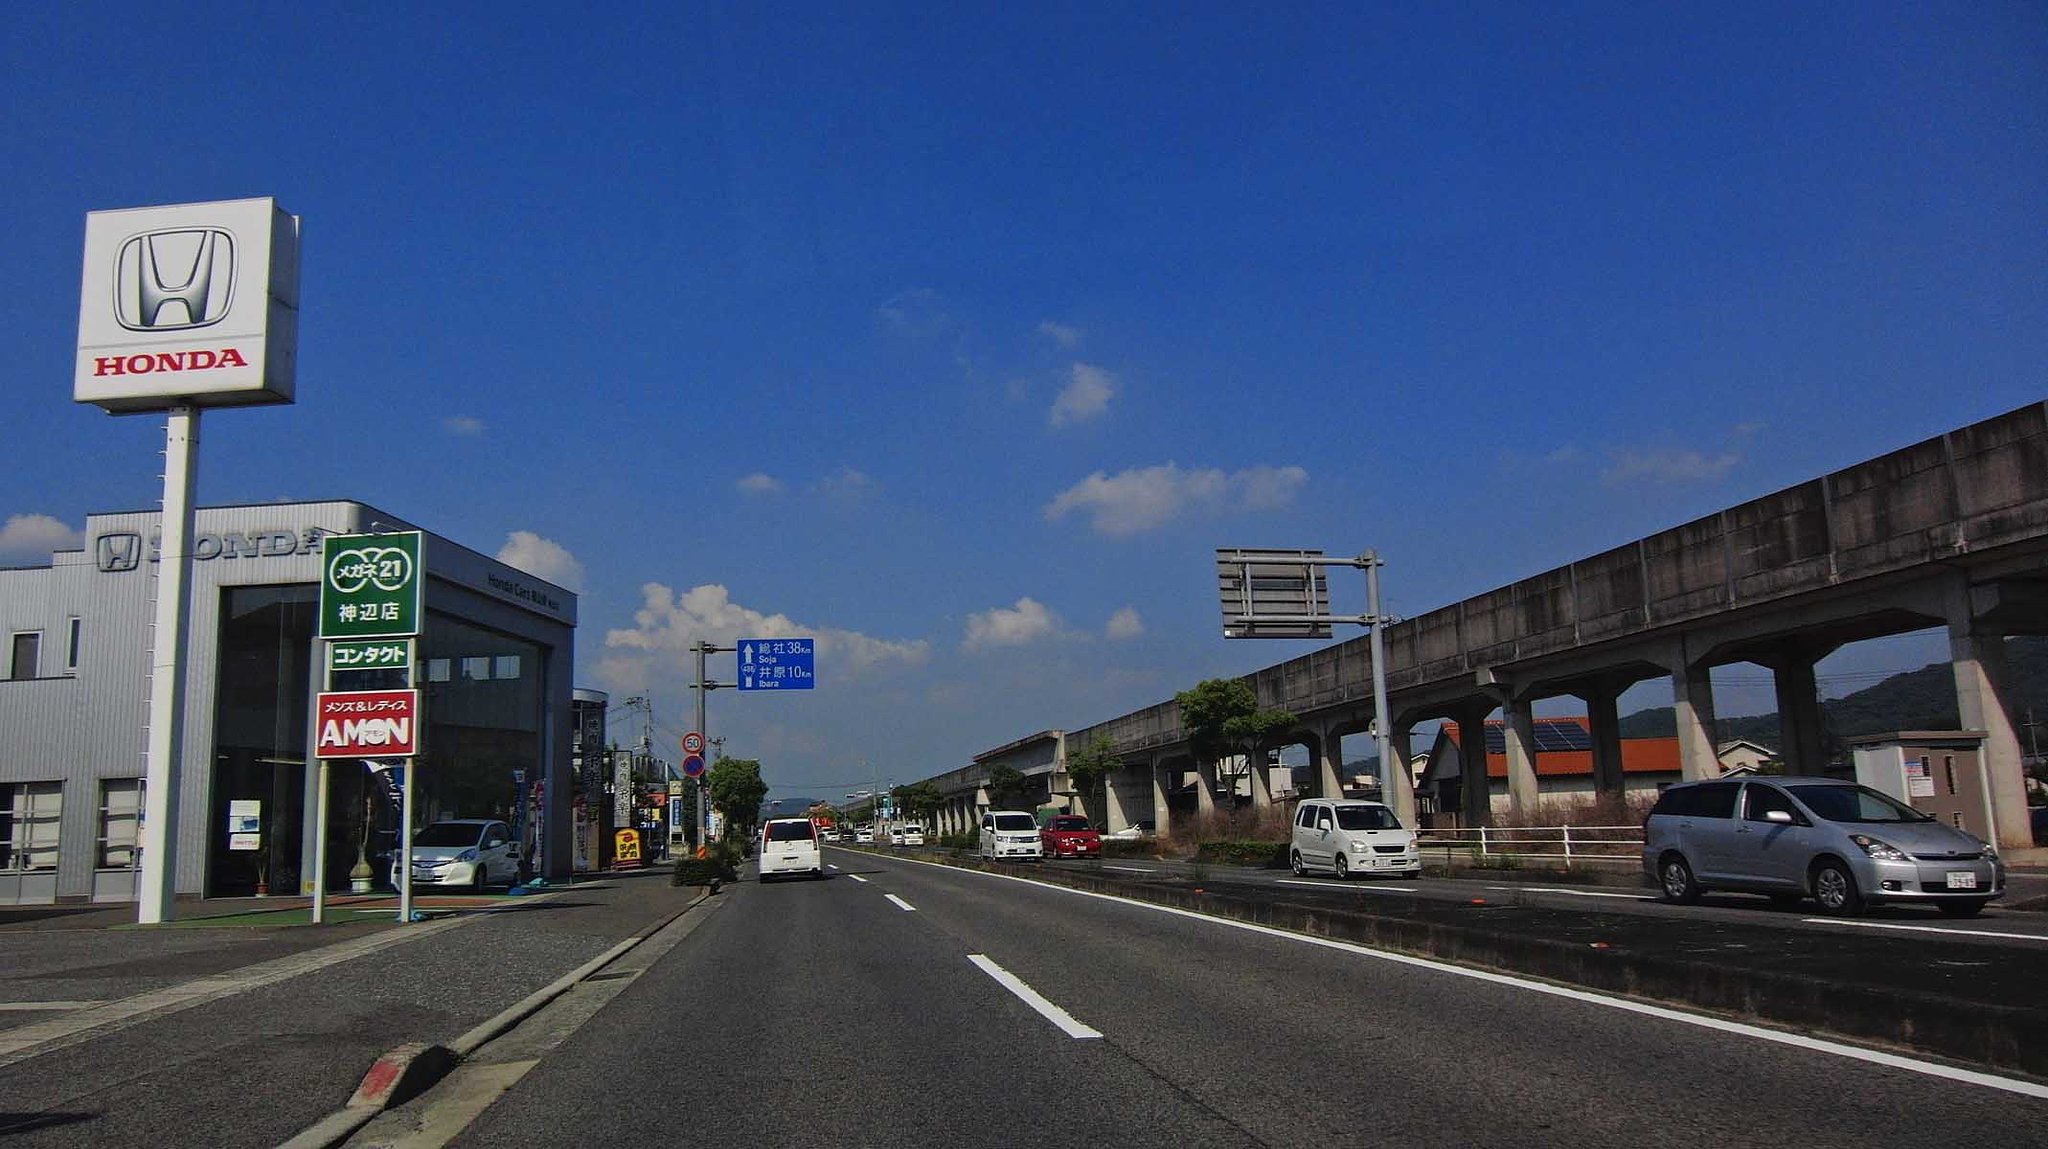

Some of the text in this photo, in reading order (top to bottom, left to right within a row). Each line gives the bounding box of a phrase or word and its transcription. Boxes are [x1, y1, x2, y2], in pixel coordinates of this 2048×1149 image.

[94, 348, 248, 376] HONDA
[150, 529, 322, 562] ONDA
[339, 602, 400, 623] 神辺店
[335, 646, 405, 665] コンタクト
[758, 642, 785, 655] 総社
[758, 655, 777, 665] Soja
[758, 666, 786, 679] 井原
[758, 680, 780, 688] Ibara
[320, 717, 410, 748] AMON
[687, 737, 699, 748] 50
